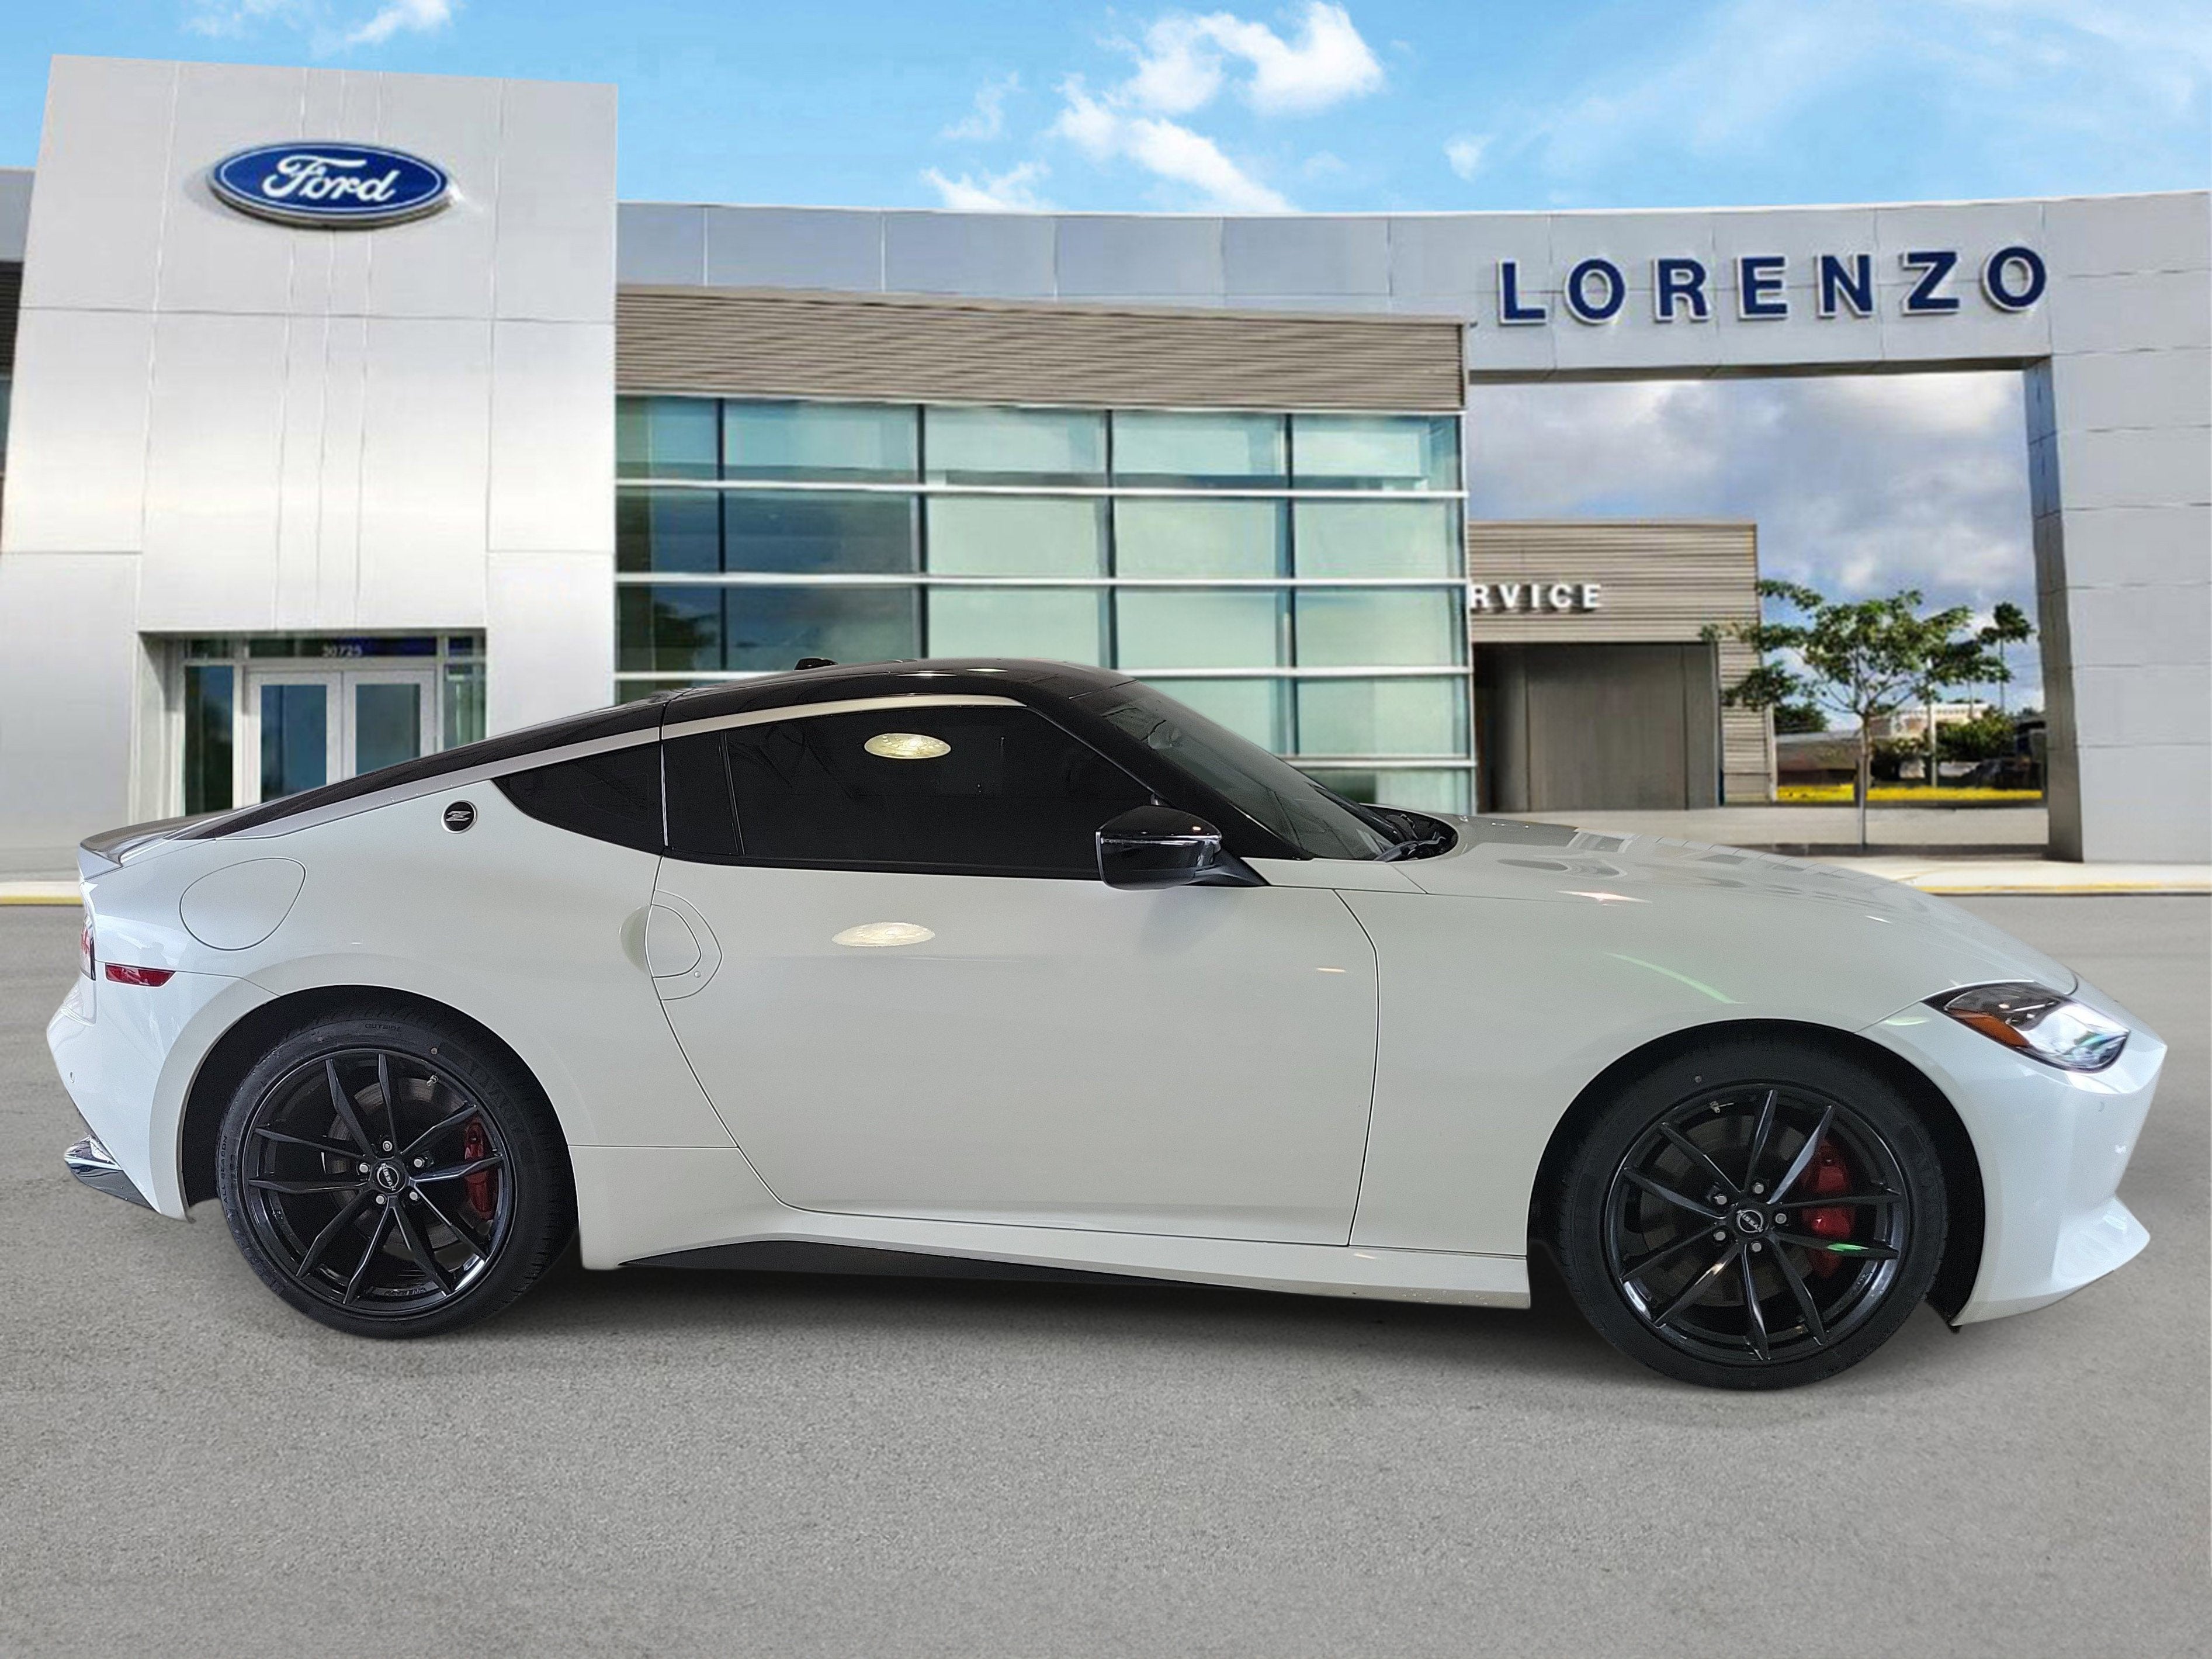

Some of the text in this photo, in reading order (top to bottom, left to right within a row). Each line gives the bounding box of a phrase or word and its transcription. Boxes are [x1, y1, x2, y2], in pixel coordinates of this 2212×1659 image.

[262, 154, 401, 202] Ford
[1497, 245, 2047, 324] LORENZO
[381, 1163, 396, 1191] NISSAN
